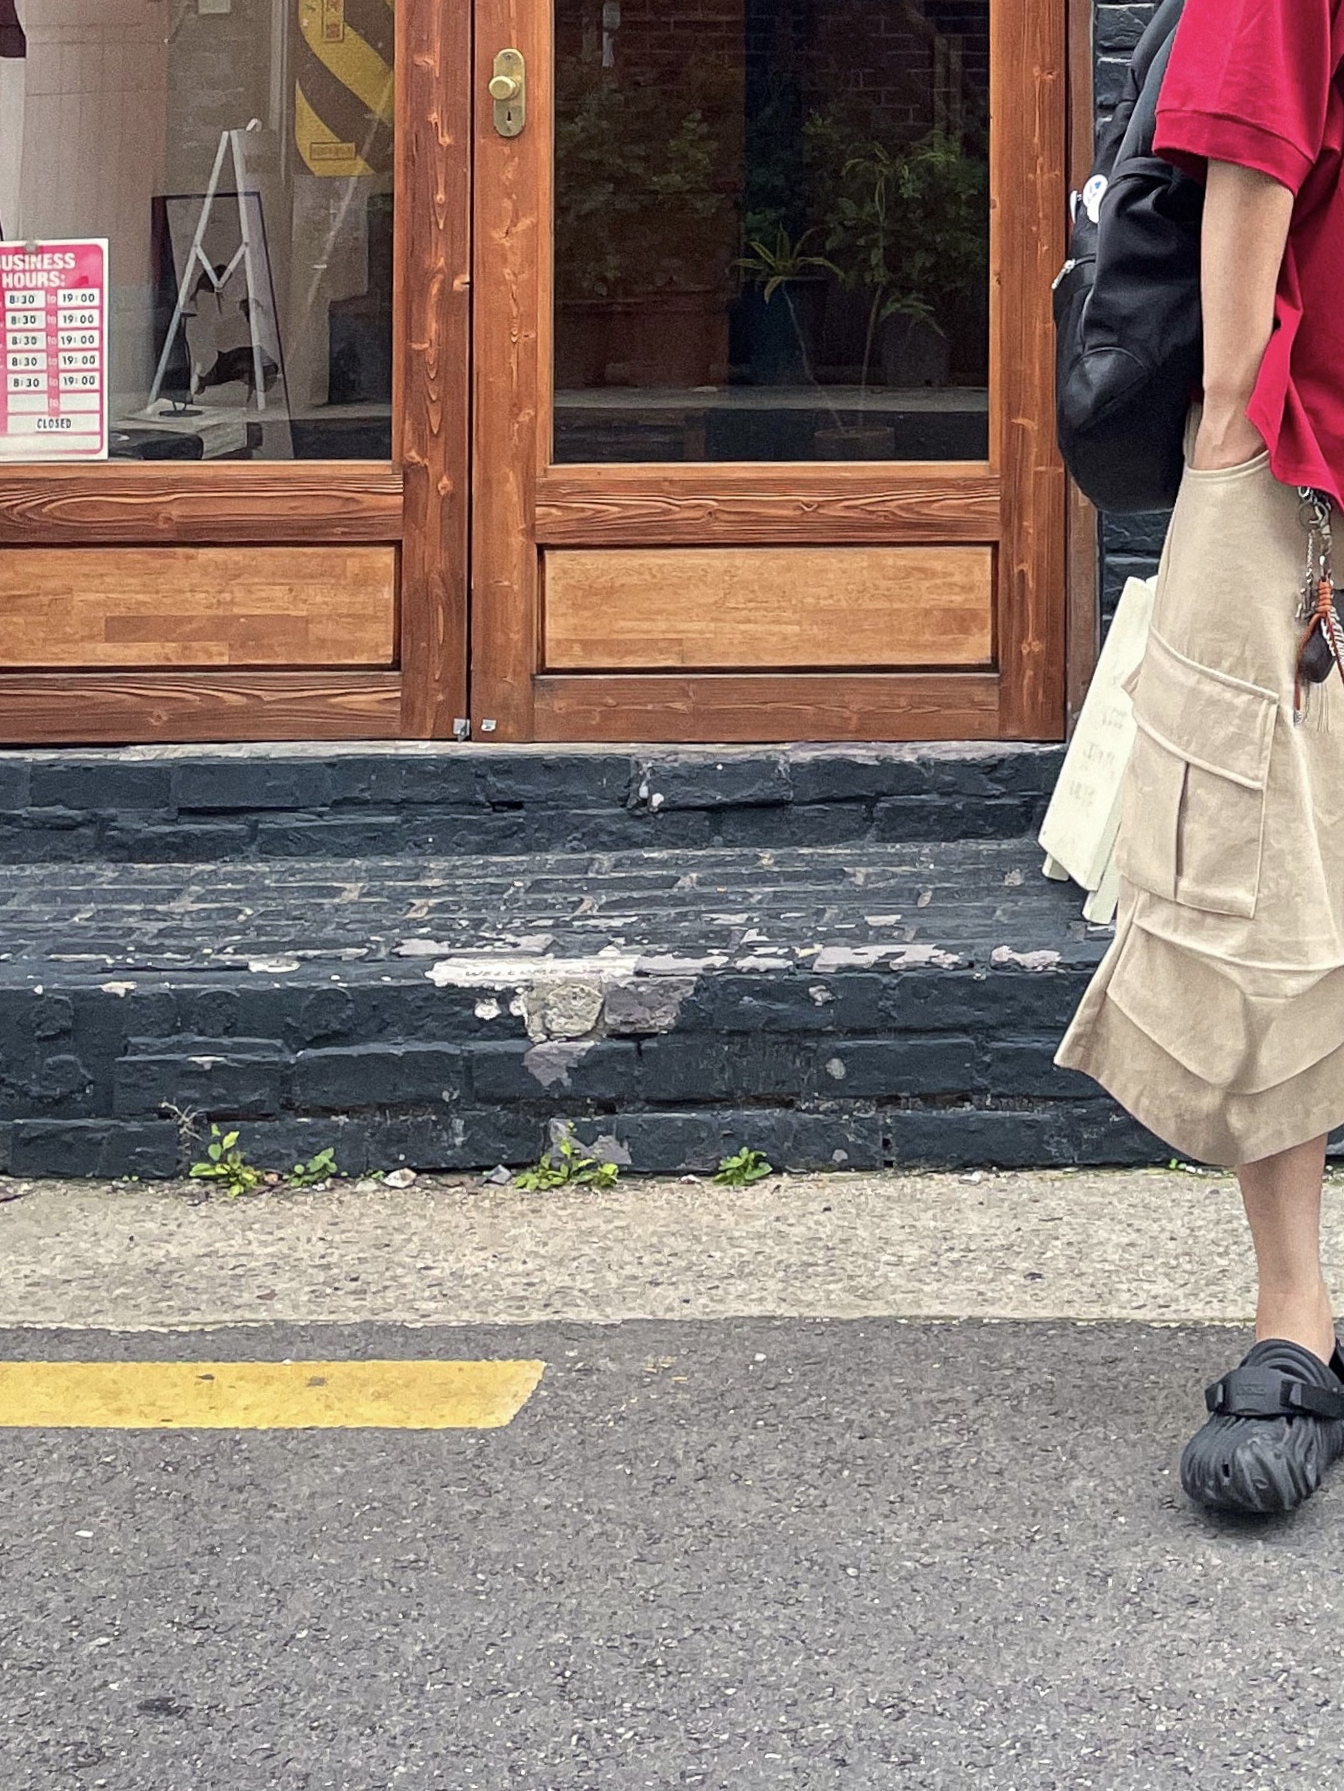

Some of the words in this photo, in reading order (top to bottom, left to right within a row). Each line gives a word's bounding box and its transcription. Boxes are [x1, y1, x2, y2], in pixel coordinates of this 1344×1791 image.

[0, 253, 76, 271] USINESS
[1, 271, 66, 289] HOURS:
[36, 418, 72, 429] CLOSED
